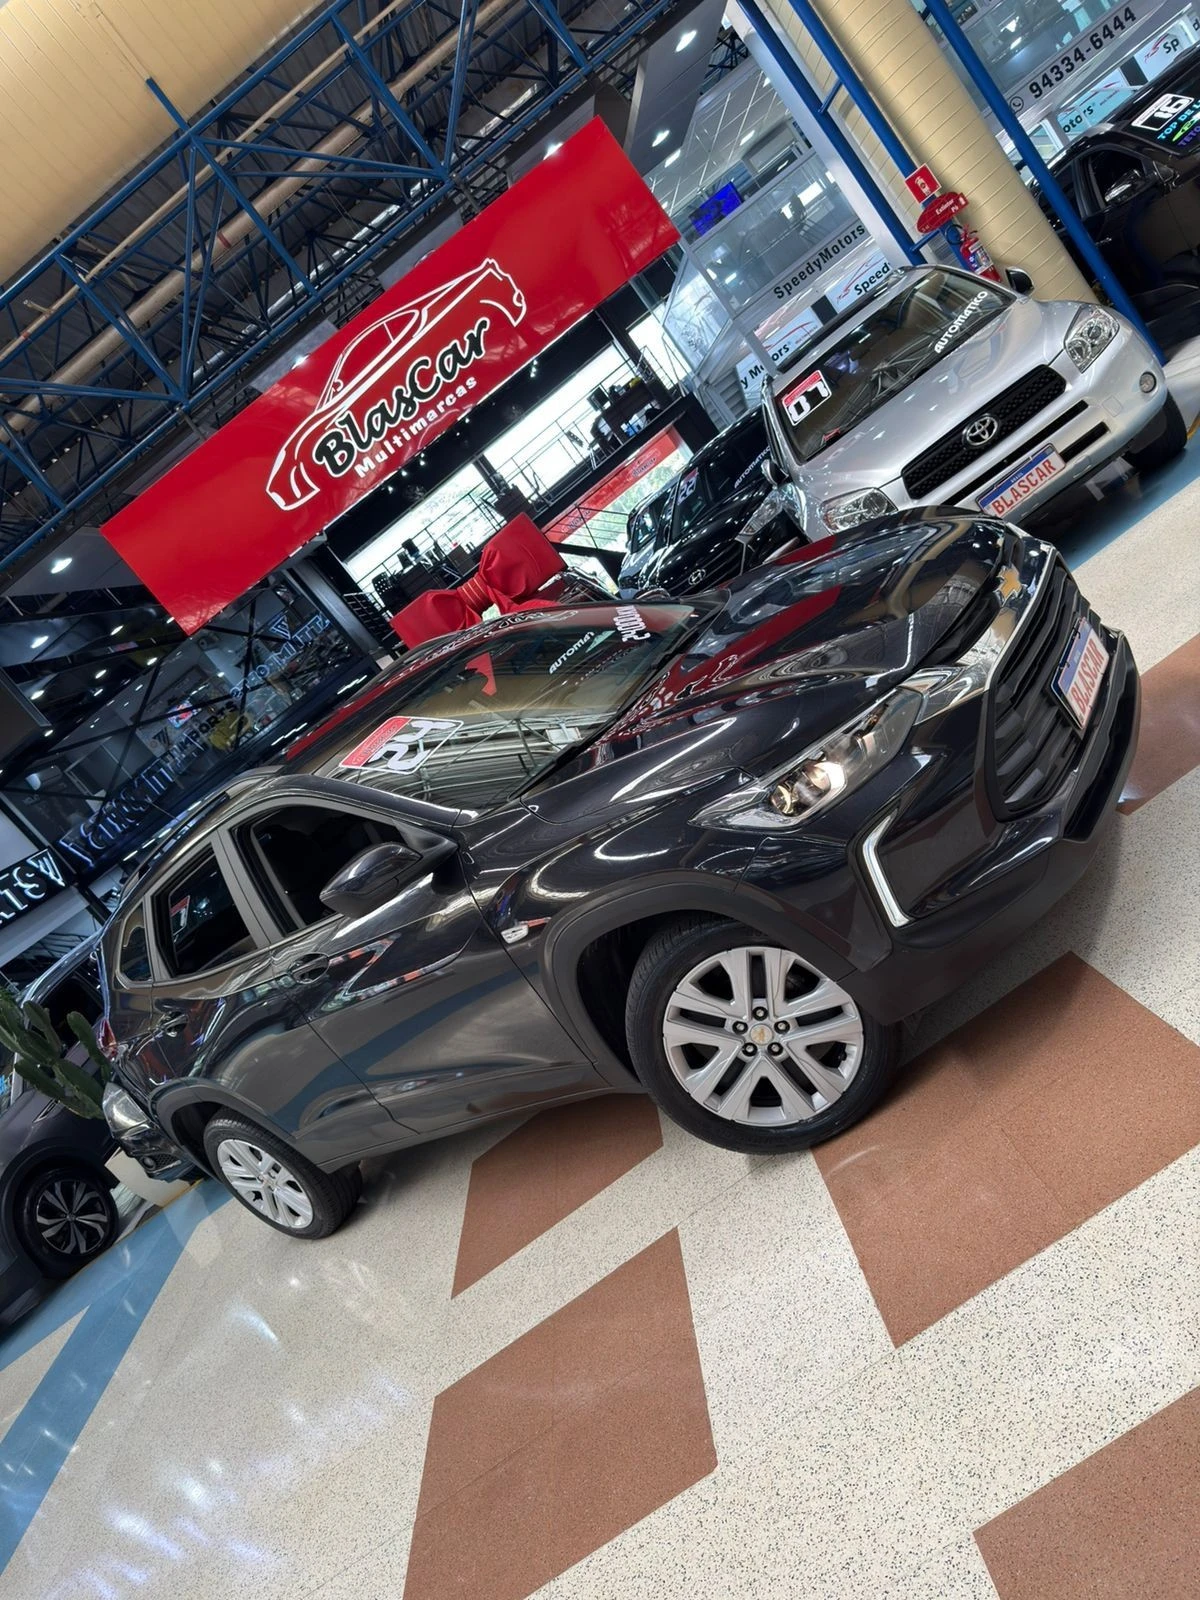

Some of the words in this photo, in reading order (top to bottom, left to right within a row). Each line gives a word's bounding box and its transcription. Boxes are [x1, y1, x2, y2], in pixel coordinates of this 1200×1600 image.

[1029, 6, 1137, 99] 94334-6444
[1062, 104, 1095, 134] otors
[1153, 98, 1191, 119] 16
[1157, 121, 1178, 139] TOP
[1178, 108, 1195, 121] DE
[773, 224, 866, 299] SpeedyMotors
[854, 261, 892, 296] Speed
[934, 290, 988, 354] AUTOMATICO
[312, 317, 490, 477] BlasCar
[354, 376, 478, 478] Multimarcas
[992, 458, 1057, 517] BLASCAR
[1070, 638, 1105, 714] BLASCAR
[367, 720, 457, 771] 24
